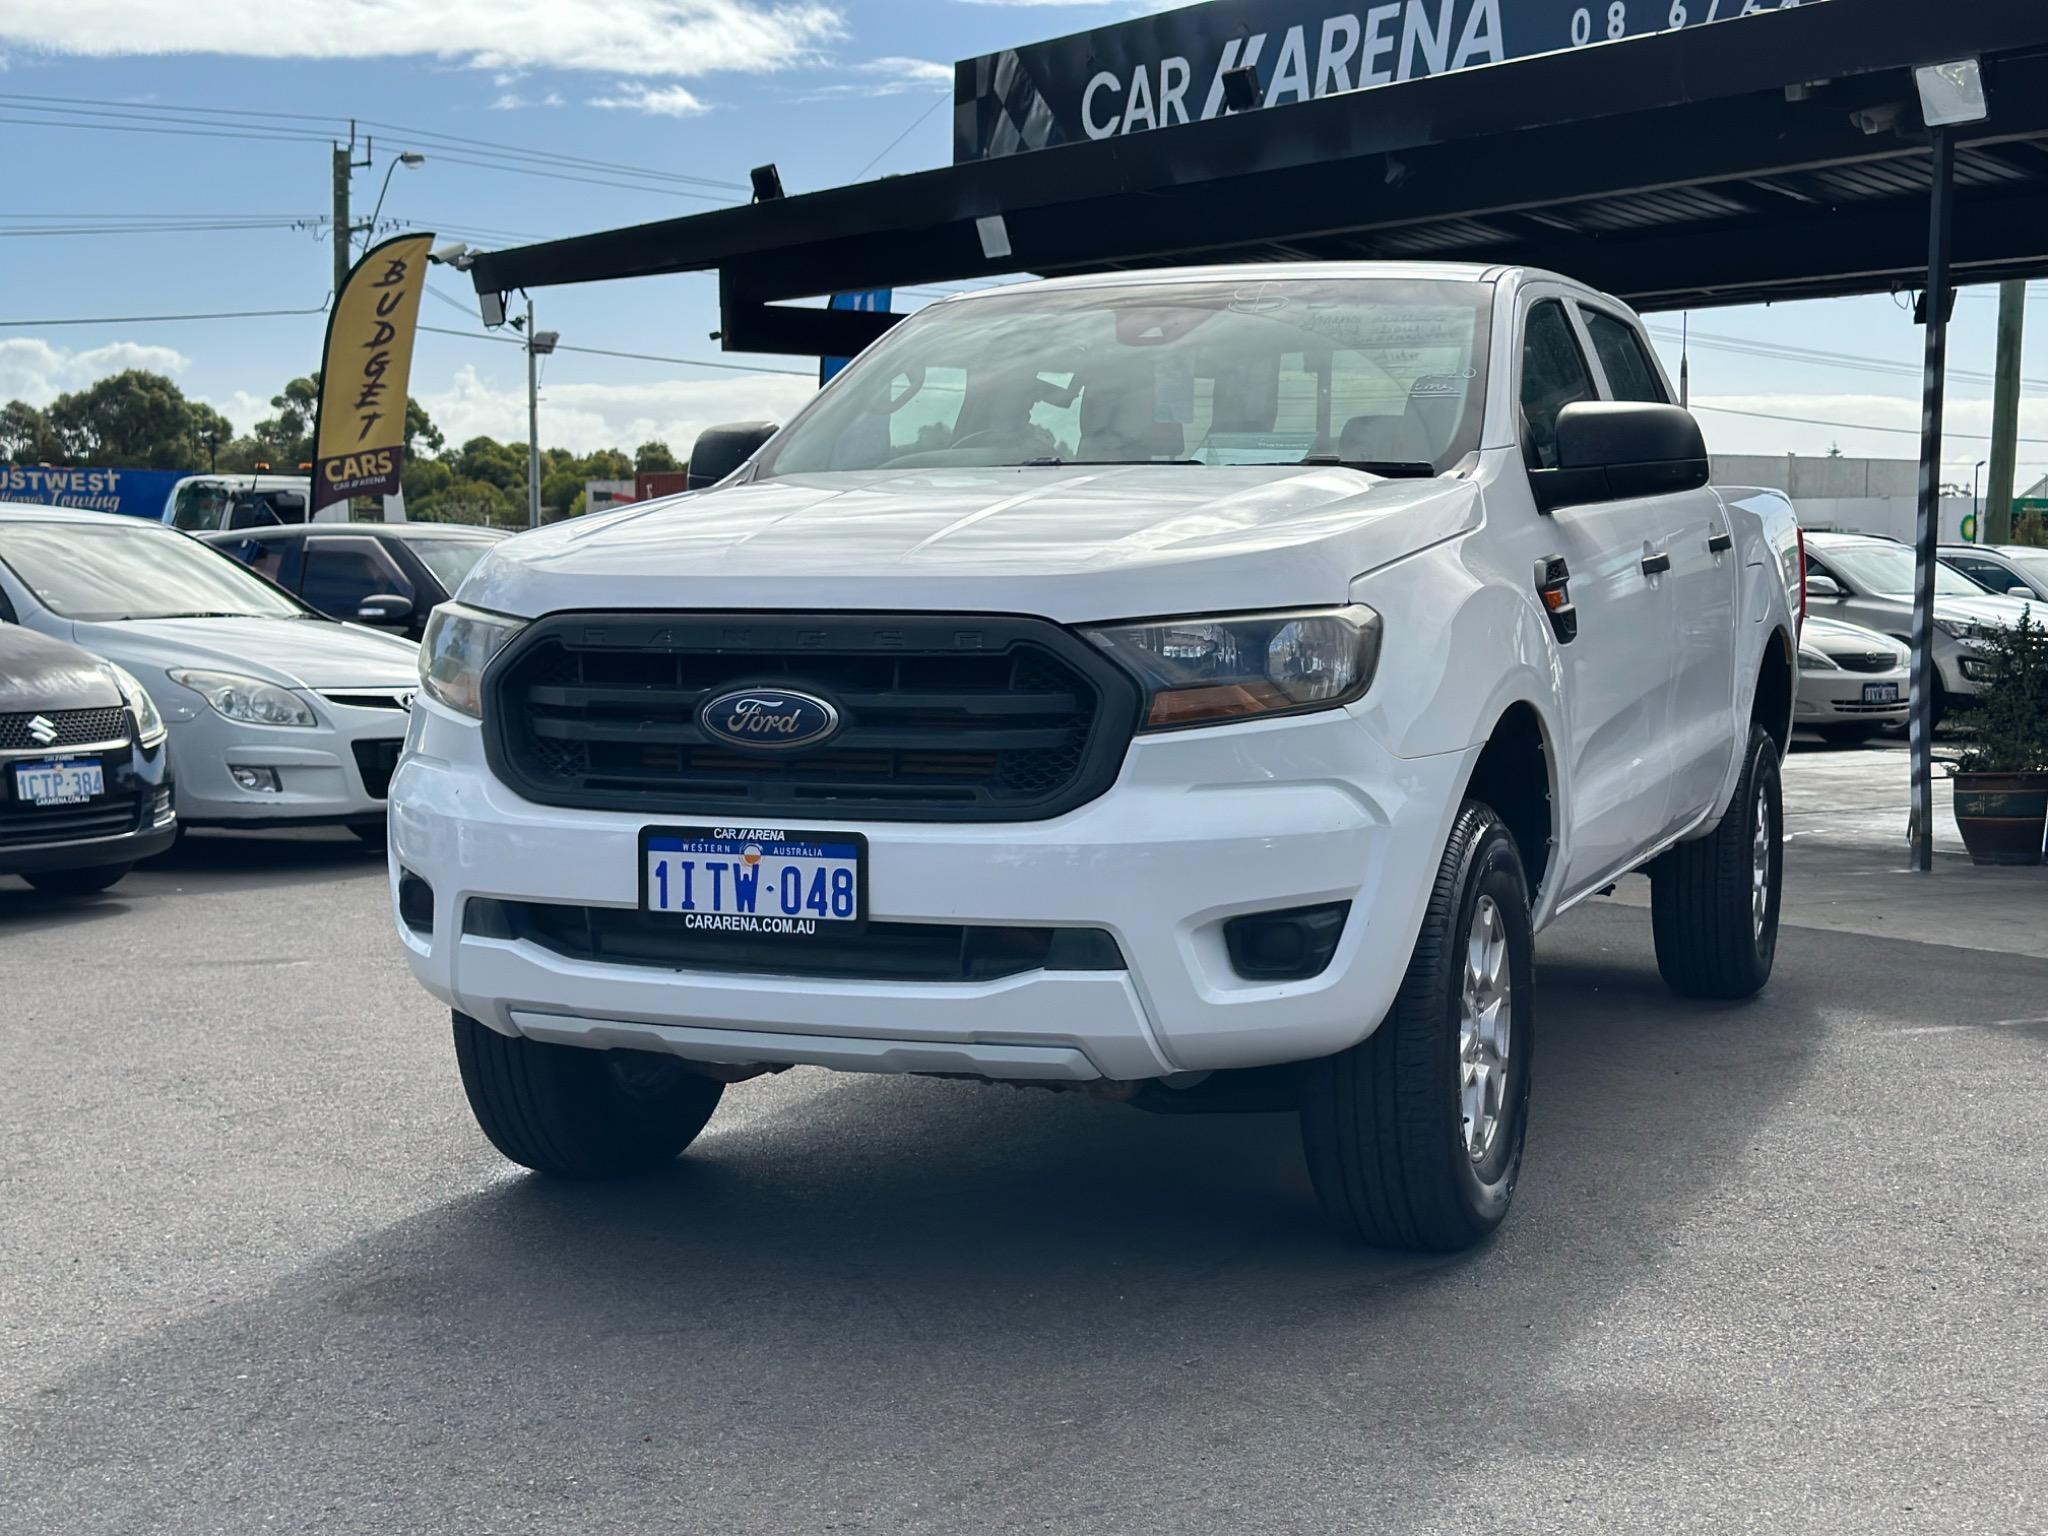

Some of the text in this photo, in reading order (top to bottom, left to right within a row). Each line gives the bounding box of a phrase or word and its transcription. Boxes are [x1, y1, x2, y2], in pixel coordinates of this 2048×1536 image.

[1571, 1, 1625, 47] 08
[1081, 56, 1190, 140] CAR
[353, 257, 407, 442] BUDGET
[325, 450, 393, 482] CARS
[727, 697, 802, 735] Ford
[682, 843, 824, 858] WESTERN AUSTRALIA
[713, 828, 786, 842] CAR ARENA
[685, 913, 816, 935] CARARENA.COM.AU
